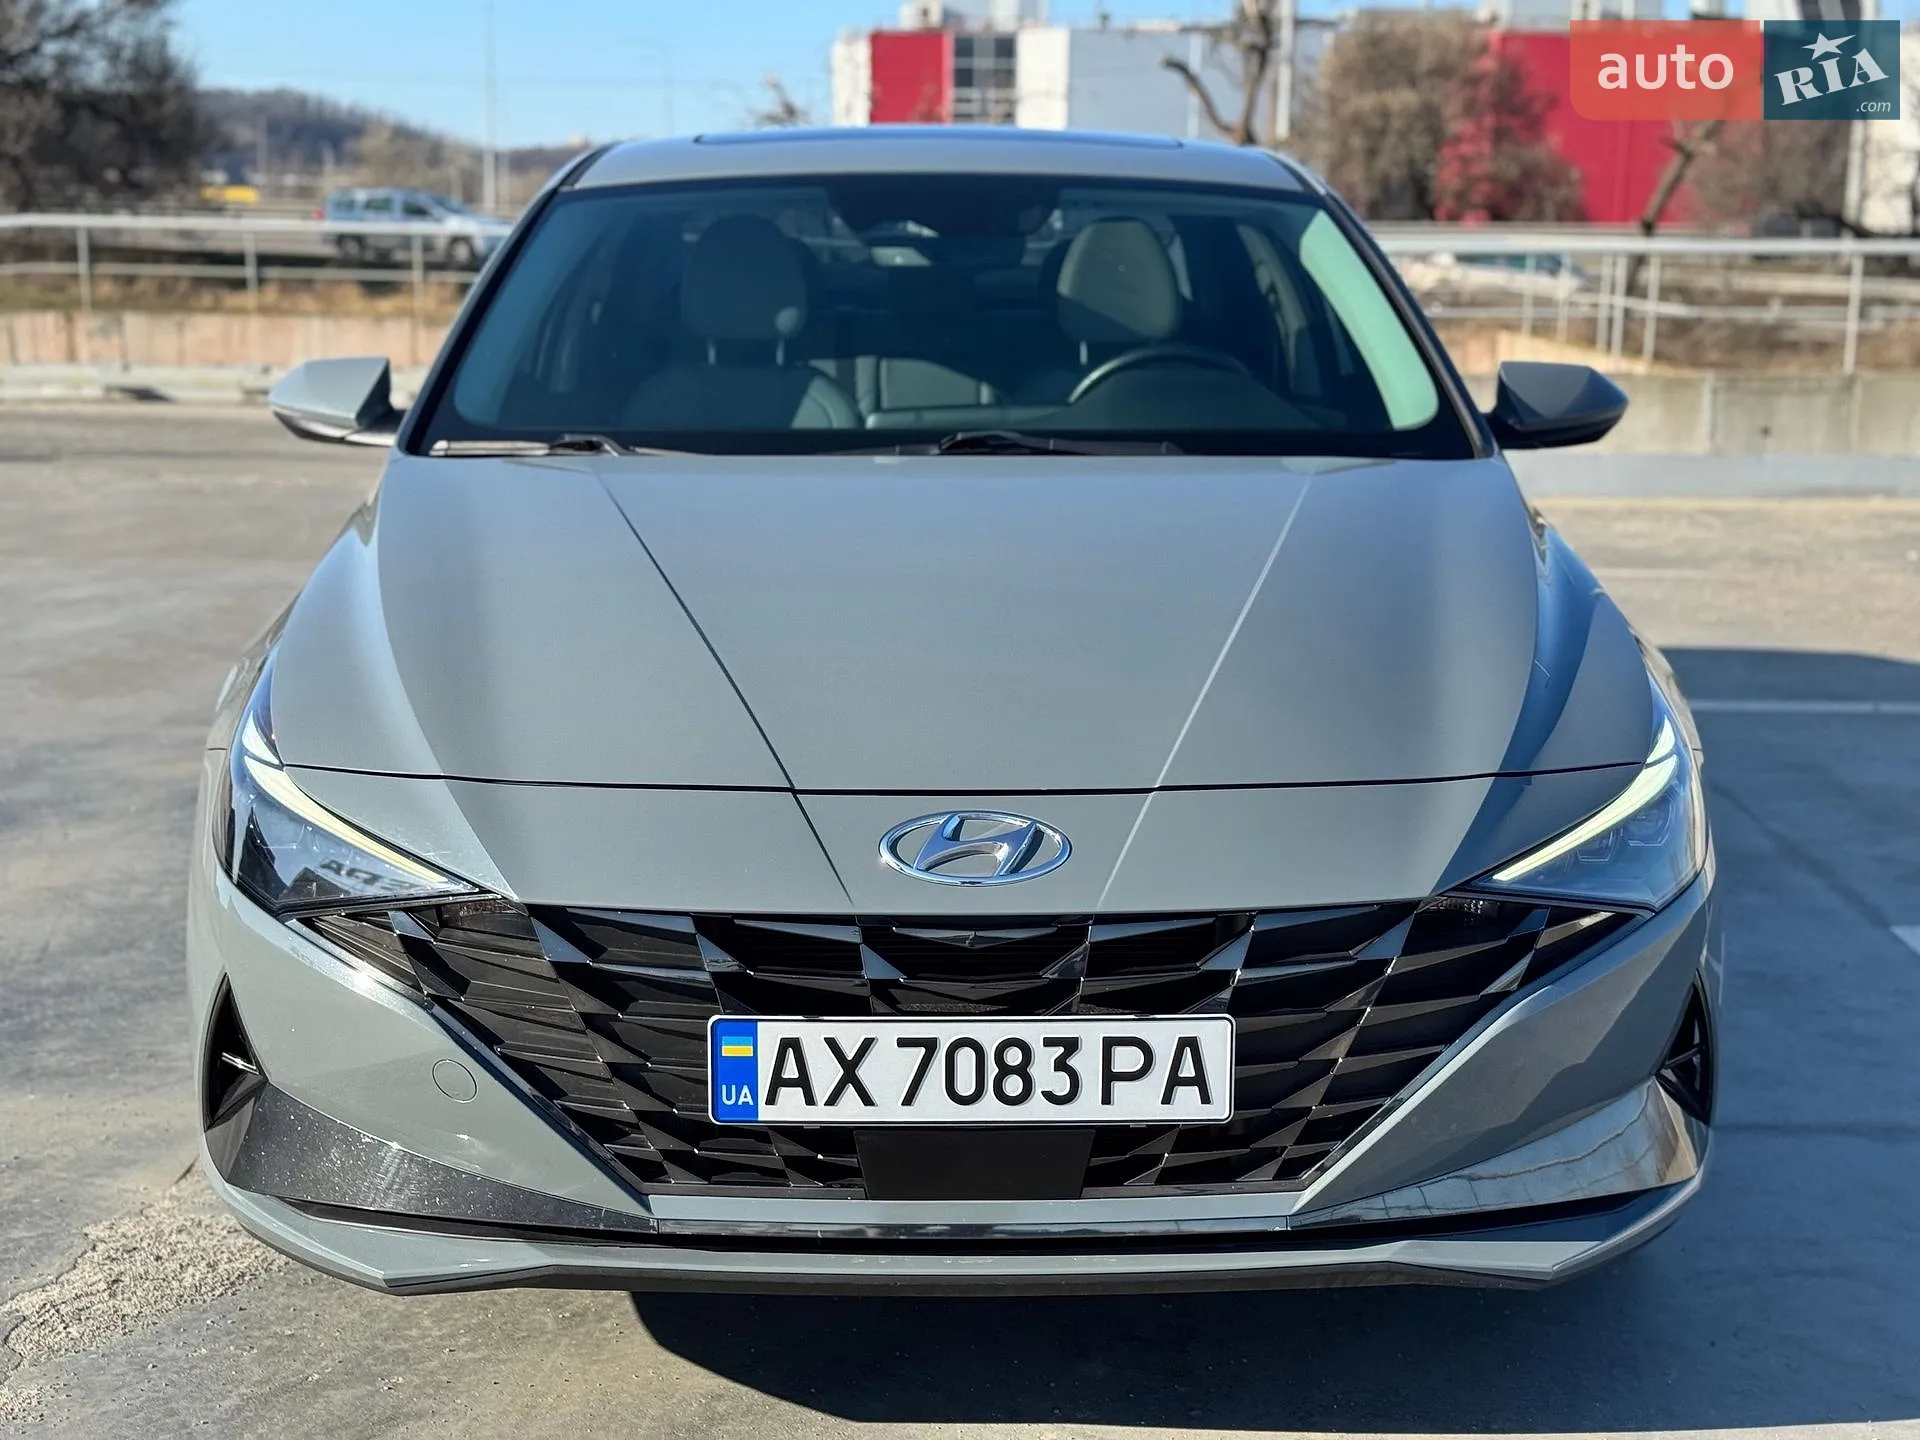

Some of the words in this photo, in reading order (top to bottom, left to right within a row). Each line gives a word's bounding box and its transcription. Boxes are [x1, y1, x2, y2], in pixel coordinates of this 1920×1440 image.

[764, 1036, 876, 1107] AX
[896, 1036, 1080, 1107] 7083
[1101, 1036, 1212, 1106] PA
[721, 1085, 754, 1106] UA
